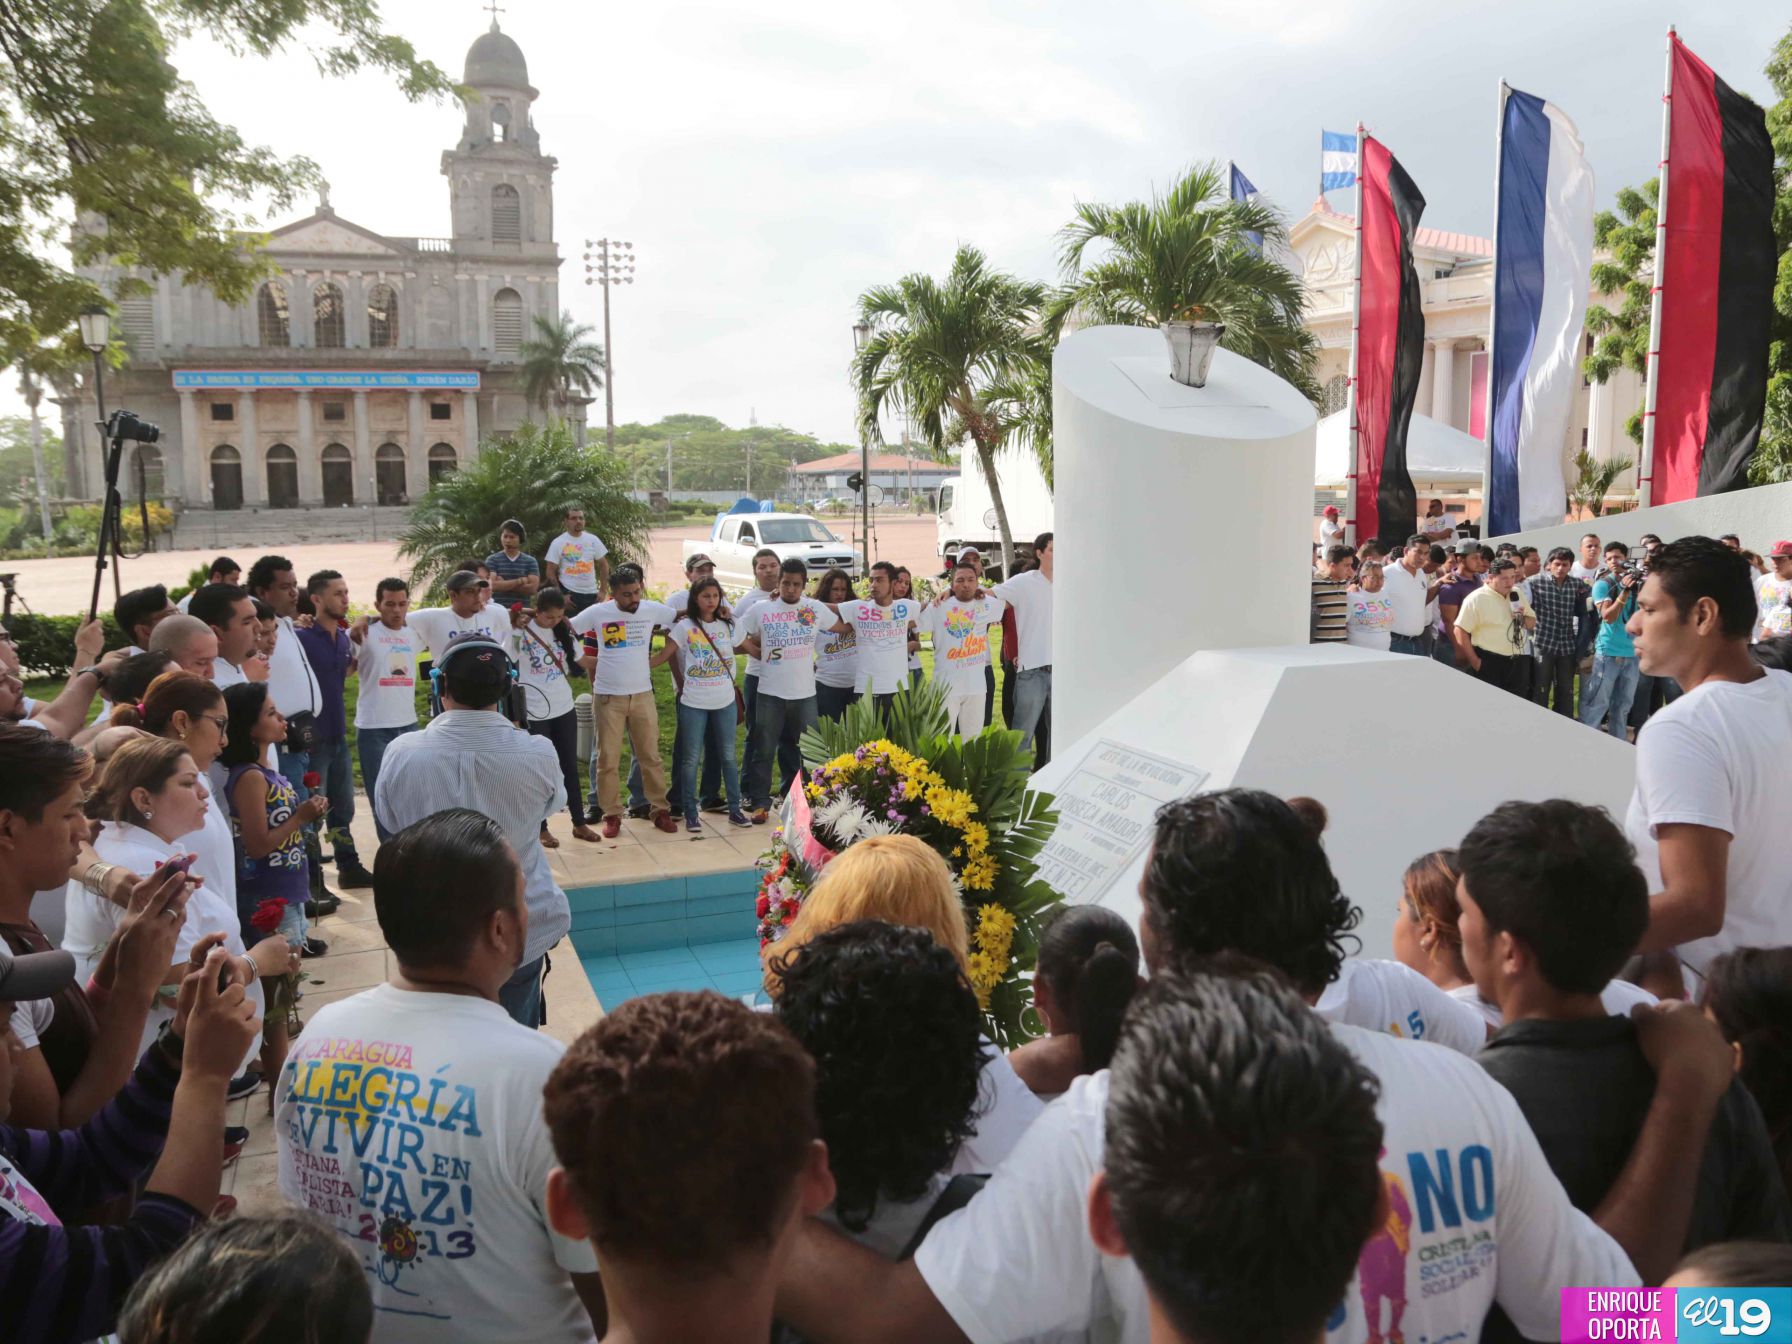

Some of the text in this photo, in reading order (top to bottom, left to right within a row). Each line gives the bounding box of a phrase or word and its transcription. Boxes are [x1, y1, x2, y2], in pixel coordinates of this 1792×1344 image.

[762, 610, 797, 624] AMOR
[763, 622, 789, 631] PARA
[857, 604, 908, 621] 35 19
[1091, 783, 1136, 810] CARLOS
[1098, 811, 1142, 842] AMADOR
[297, 1105, 427, 1174] VIVIR
[431, 1153, 471, 1182] EN
[360, 1162, 475, 1228] PAZ!
[1407, 1145, 1496, 1233] NO
